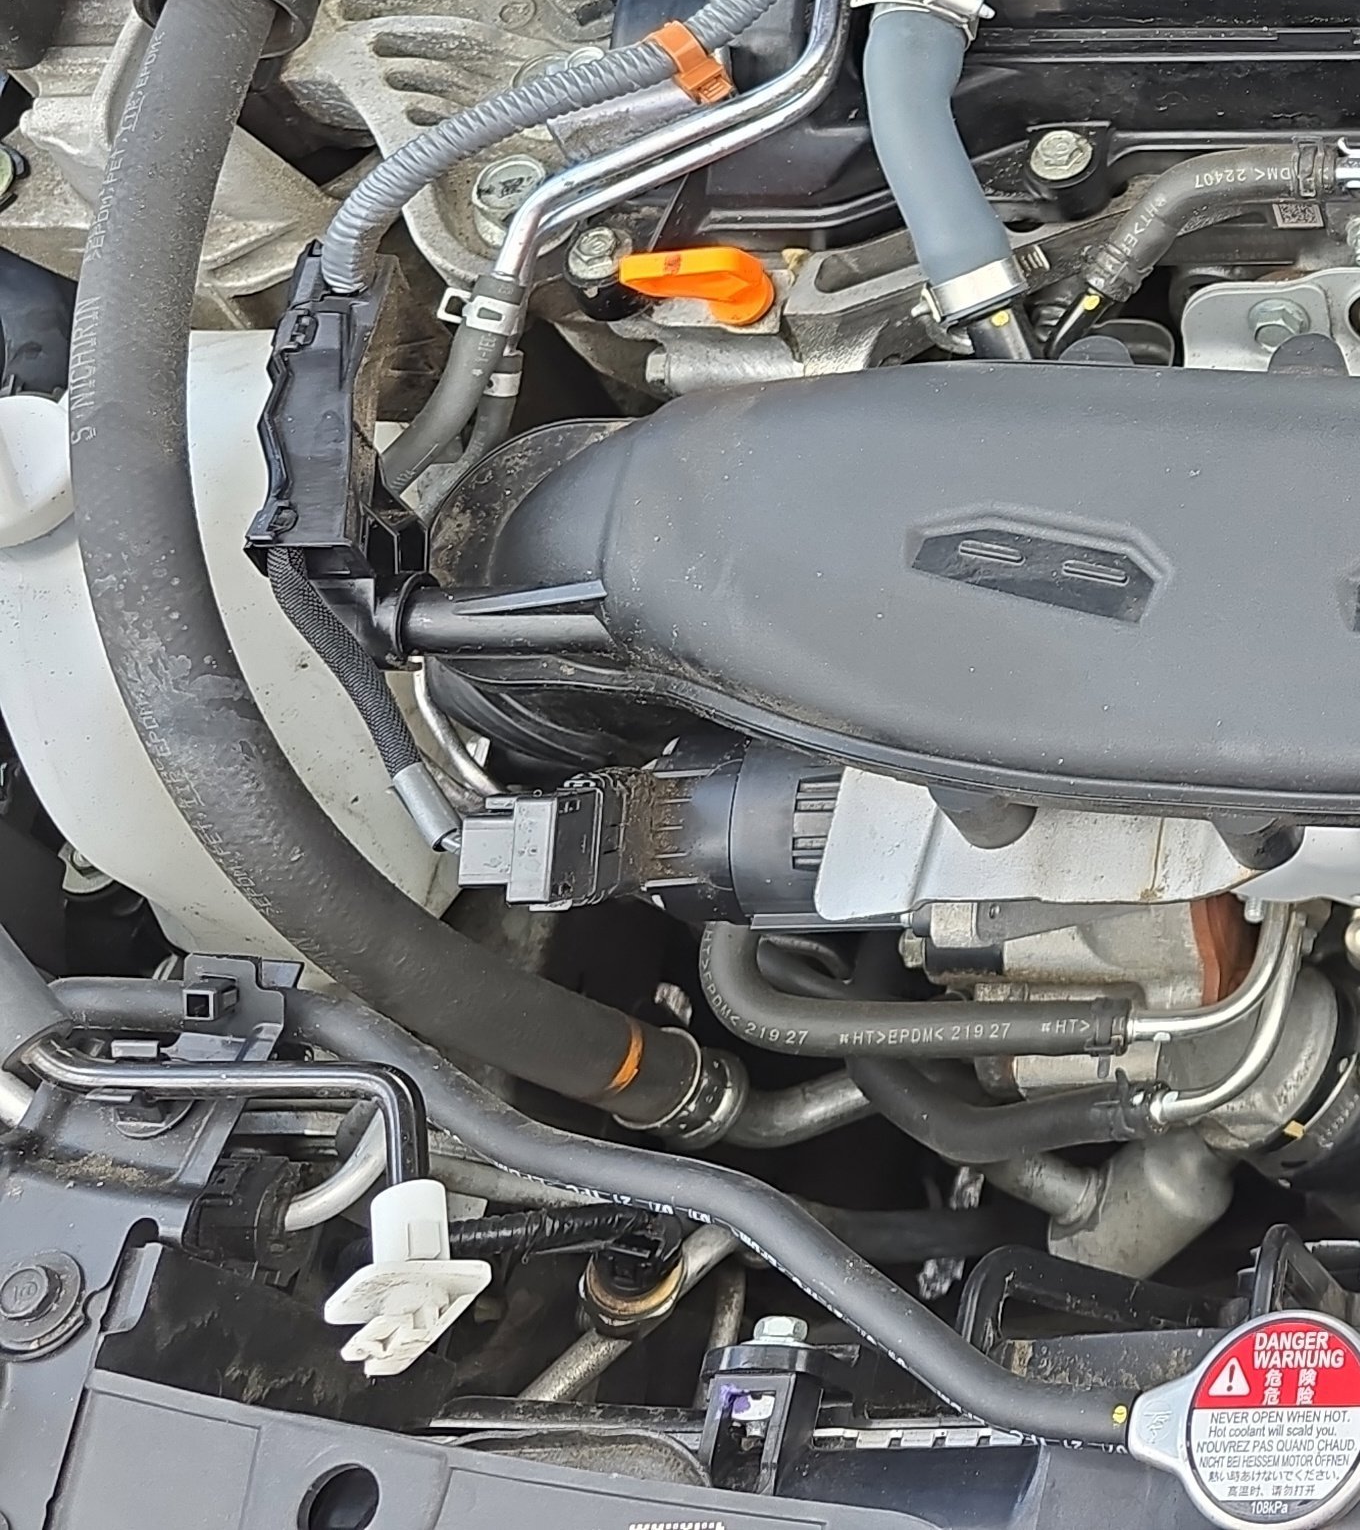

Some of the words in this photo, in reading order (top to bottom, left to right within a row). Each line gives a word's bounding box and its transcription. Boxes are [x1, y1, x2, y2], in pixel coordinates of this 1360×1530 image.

[1193, 167, 1247, 189] 22407
[69, 295, 100, 414] NICHIRIN
[1254, 1331, 1329, 1351] DANGER
[1253, 1349, 1345, 1369] WARNUNG
[1210, 1411, 1249, 1424] NEVER
[1251, 1411, 1284, 1424] OPEN
[1286, 1410, 1322, 1423] WHEN
[1324, 1409, 1351, 1423] HOT.
[1208, 1426, 1227, 1438] Hot
[1228, 1424, 1266, 1437] coolant
[1268, 1424, 1284, 1436] will
[1286, 1424, 1313, 1436] scald
[1315, 1425, 1337, 1439] you.
[1196, 1440, 1250, 1454] N'OUVREZ
[1252, 1440, 1274, 1453] PAS
[1276, 1439, 1315, 1454] QUAND
[1317, 1438, 1358, 1453] CHAUD.
[1198, 1455, 1225, 1468] NICHT
[1226, 1455, 1241, 1468] BEI
[1242, 1454, 1280, 1467] HEISSEM
[1281, 1454, 1313, 1467] MOTOR
[1314, 1451, 1350, 1467] ÖFFNEN
[1249, 1501, 1289, 1515] 108kPa
